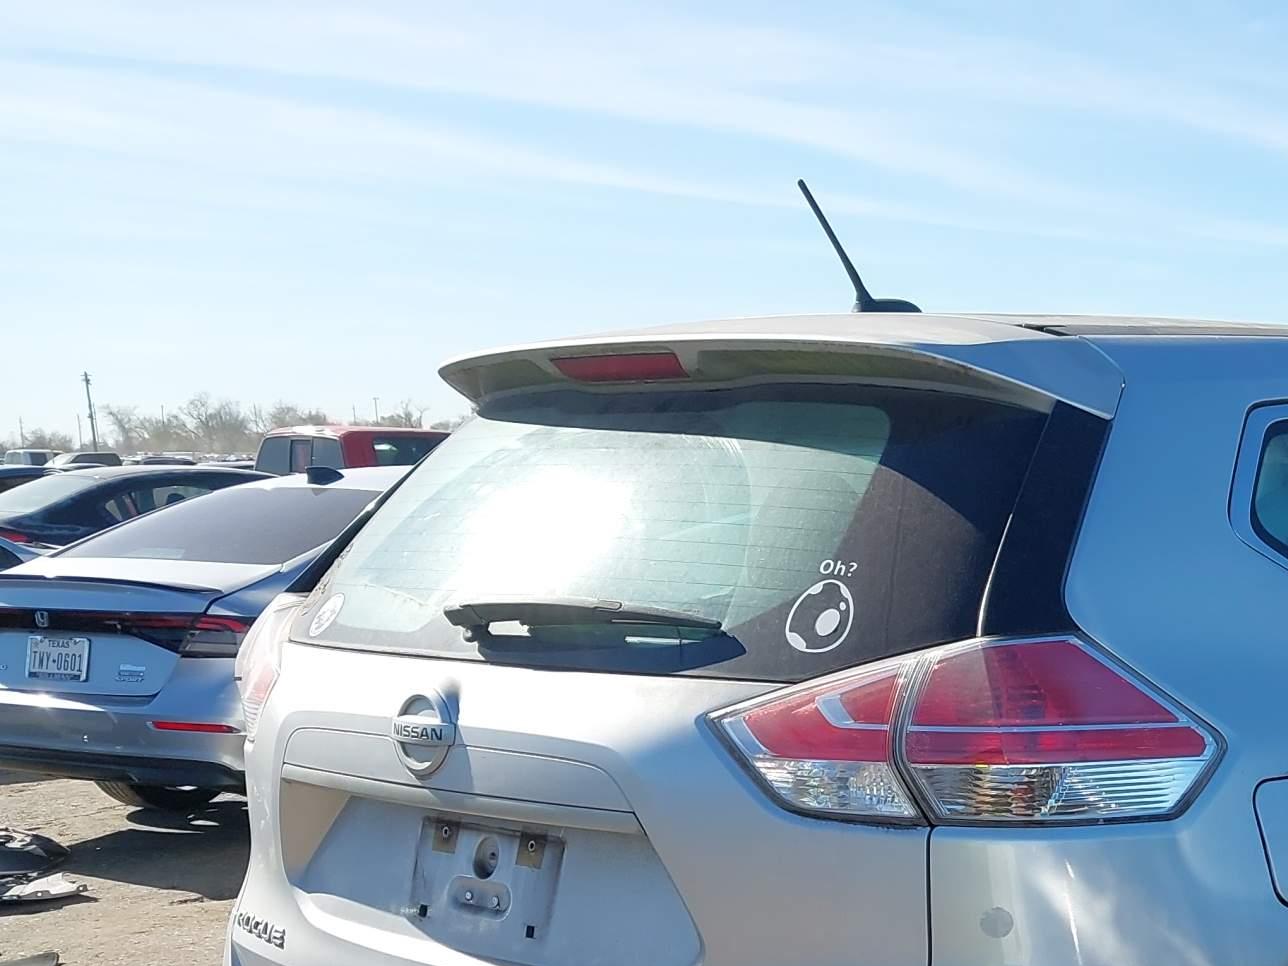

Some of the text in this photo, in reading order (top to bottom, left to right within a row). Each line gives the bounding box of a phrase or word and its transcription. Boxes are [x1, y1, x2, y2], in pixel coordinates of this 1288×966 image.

[819, 559, 858, 577] Oh?
[47, 639, 70, 648] TEXAS
[393, 722, 443, 741] NISSAN
